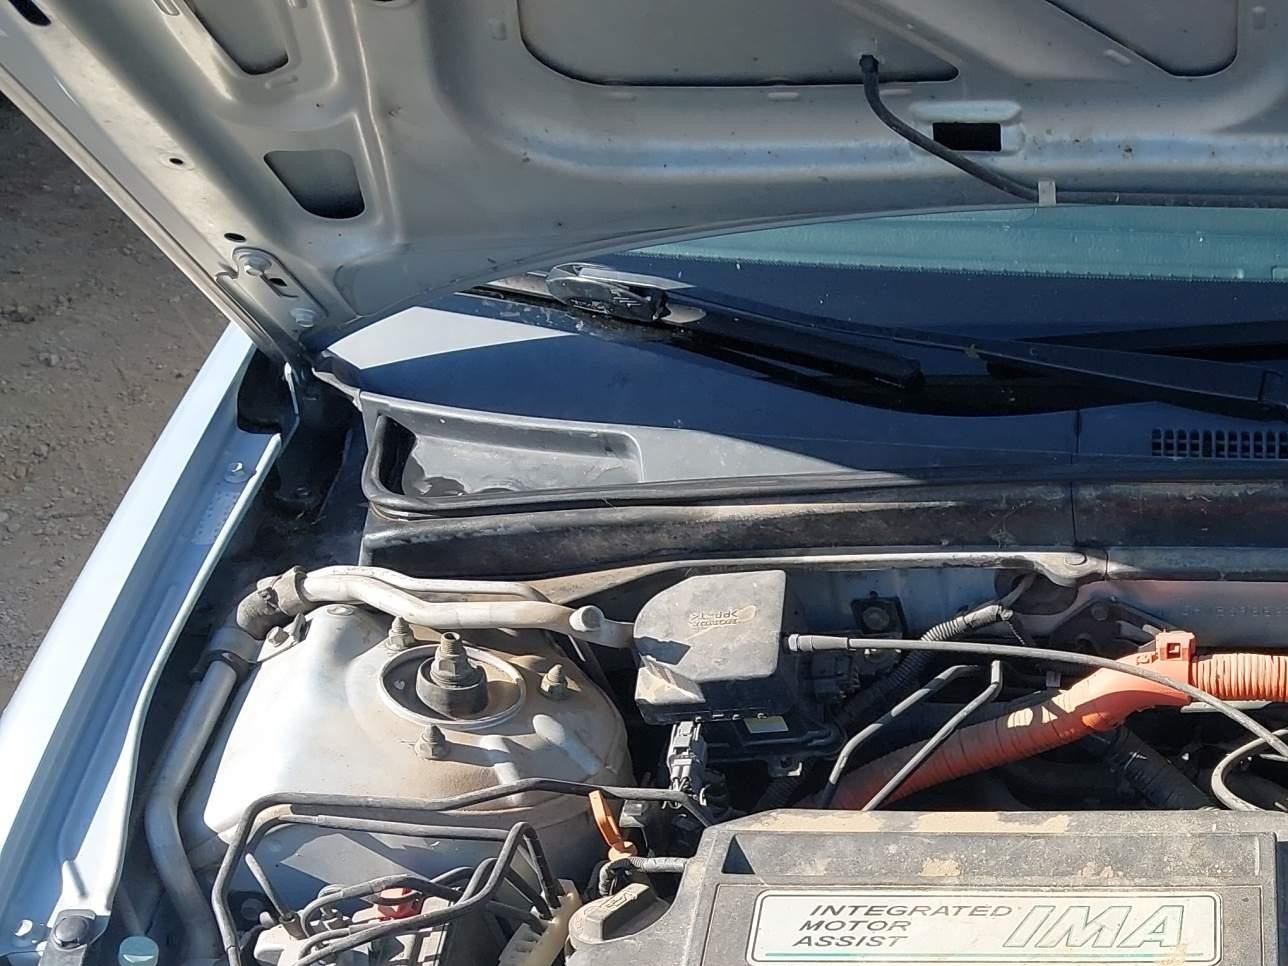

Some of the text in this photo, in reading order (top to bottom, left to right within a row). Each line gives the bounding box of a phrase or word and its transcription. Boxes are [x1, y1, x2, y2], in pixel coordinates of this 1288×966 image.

[809, 904, 1013, 917] INTEGRATED
[798, 919, 912, 933] MOTOR
[1000, 904, 1187, 949] IMA
[792, 935, 909, 948] ASSIST
